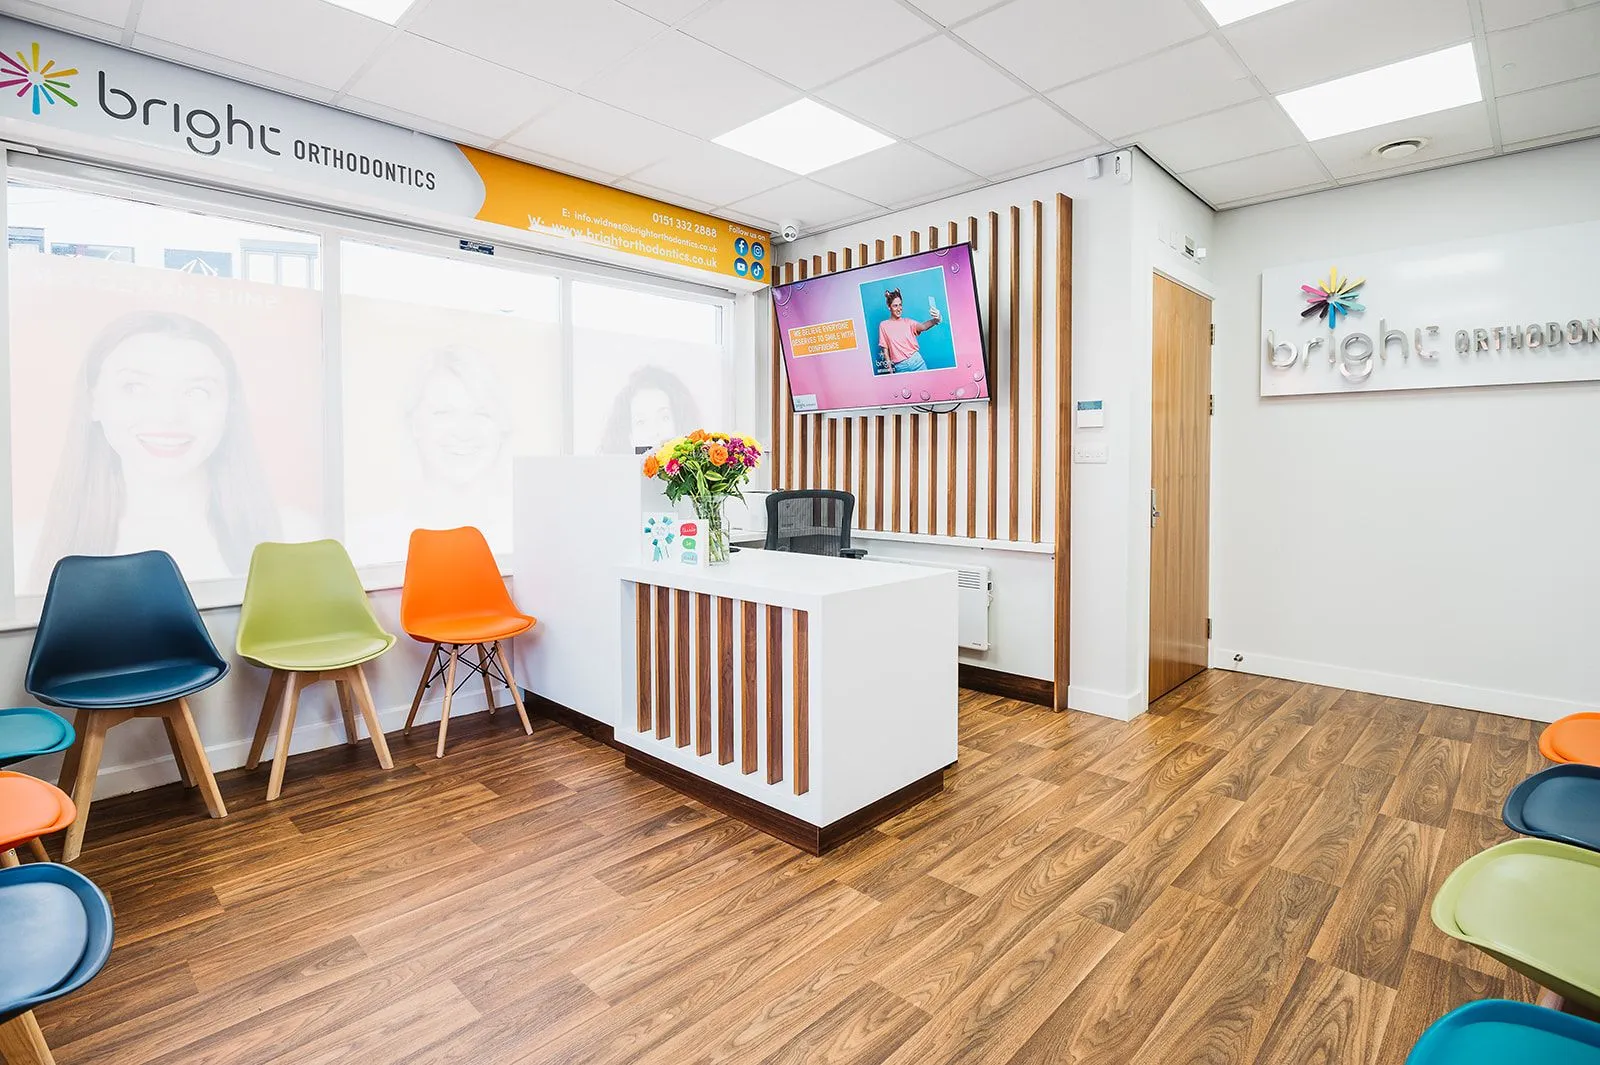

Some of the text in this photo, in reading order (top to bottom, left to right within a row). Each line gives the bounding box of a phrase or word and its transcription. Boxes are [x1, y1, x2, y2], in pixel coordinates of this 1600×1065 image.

[98, 70, 436, 191] bright ORTHODONTICS
[561, 207, 718, 253] E: info.widnes@brightorthodontics.co.uk
[652, 212, 717, 238] 0151 332 2888
[728, 224, 749, 241] Follow
[757, 234, 766, 242] on
[808, 342, 840, 353] CONFIDENCE
[825, 332, 841, 342] SMILE
[1266, 317, 1600, 382] bright ORTHODON
